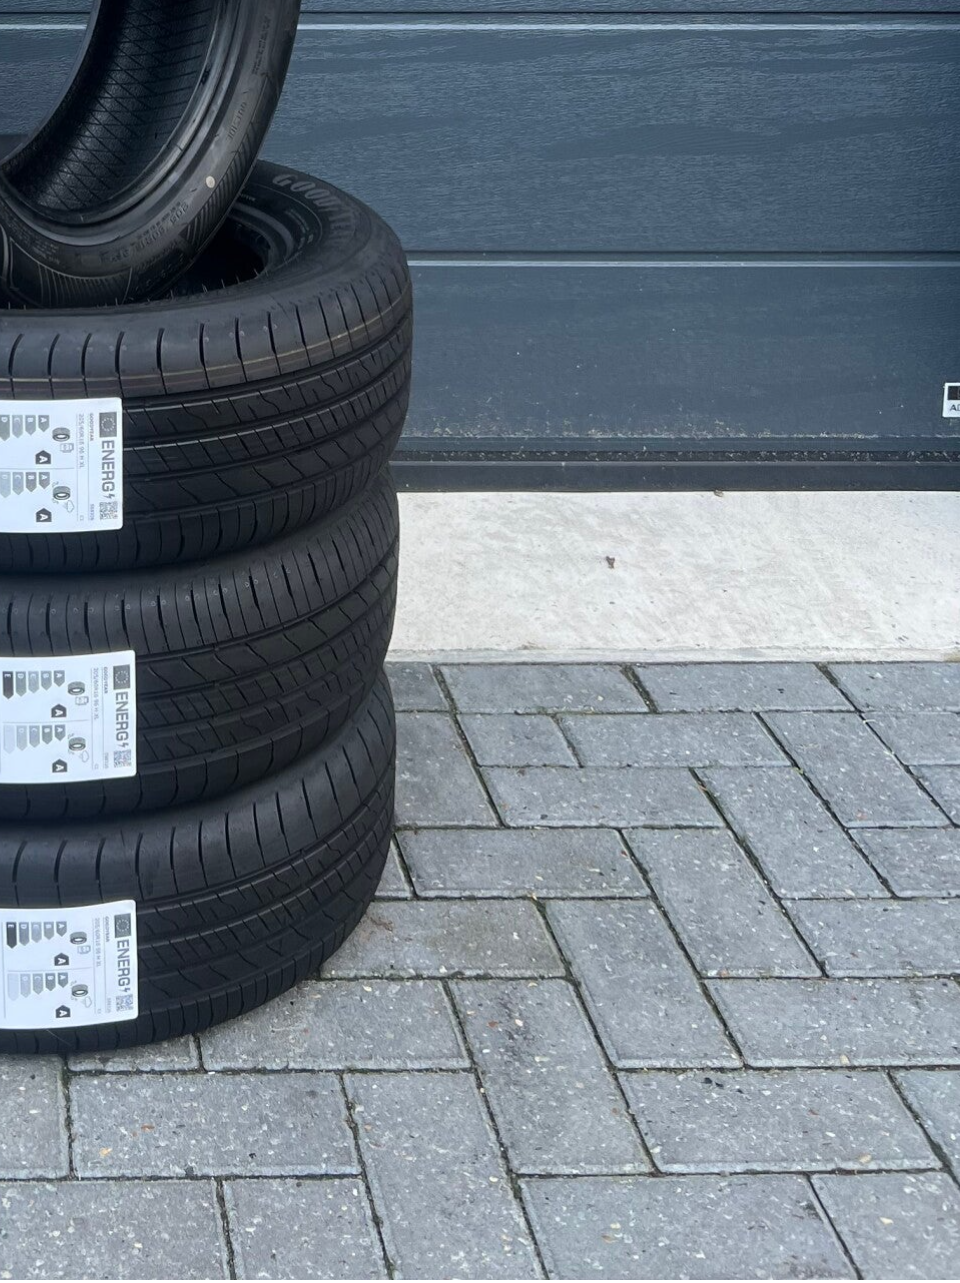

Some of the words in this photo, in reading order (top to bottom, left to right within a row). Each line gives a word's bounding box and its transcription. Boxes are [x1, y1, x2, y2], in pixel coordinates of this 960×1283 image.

[102, 440, 115, 492] ENERG
[116, 692, 128, 741] ENERG
[117, 940, 130, 986] ENERG
